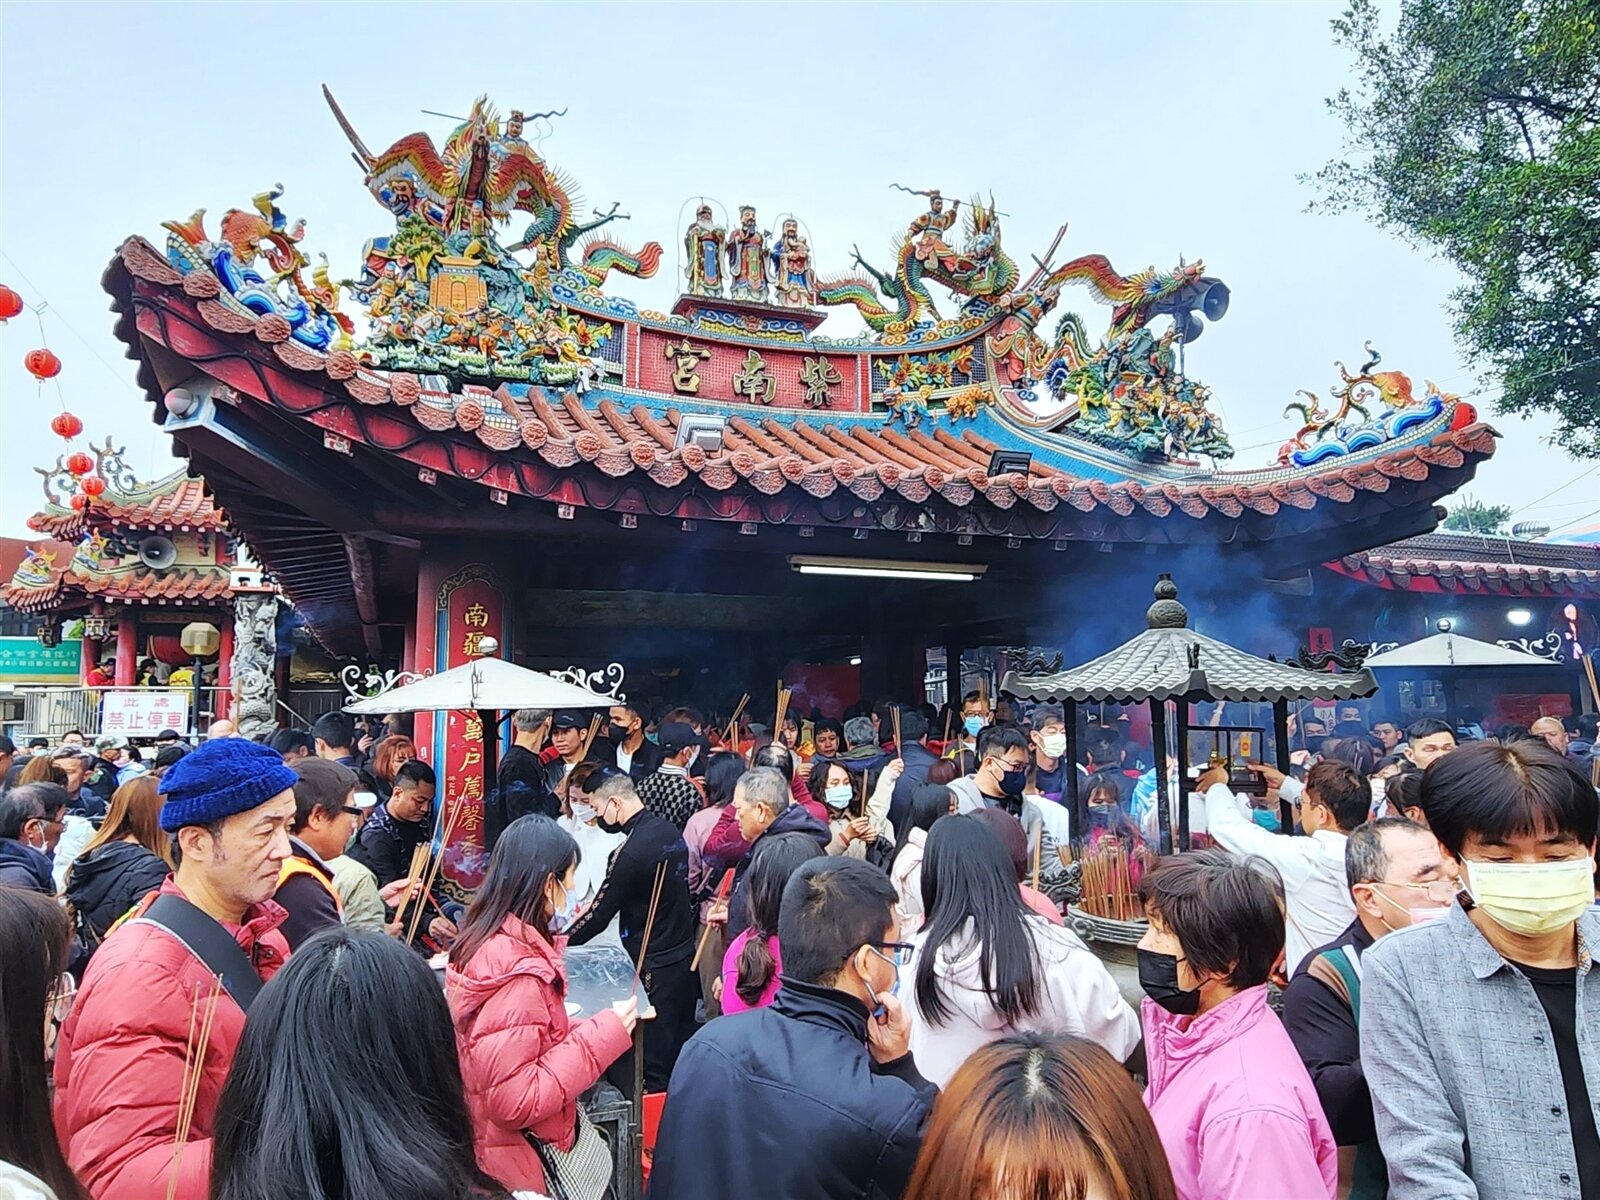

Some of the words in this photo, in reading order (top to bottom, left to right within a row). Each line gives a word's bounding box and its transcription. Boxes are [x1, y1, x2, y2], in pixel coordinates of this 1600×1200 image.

[664, 340, 843, 407] 紫南宮
[107, 711, 182, 730] 禁止停車
